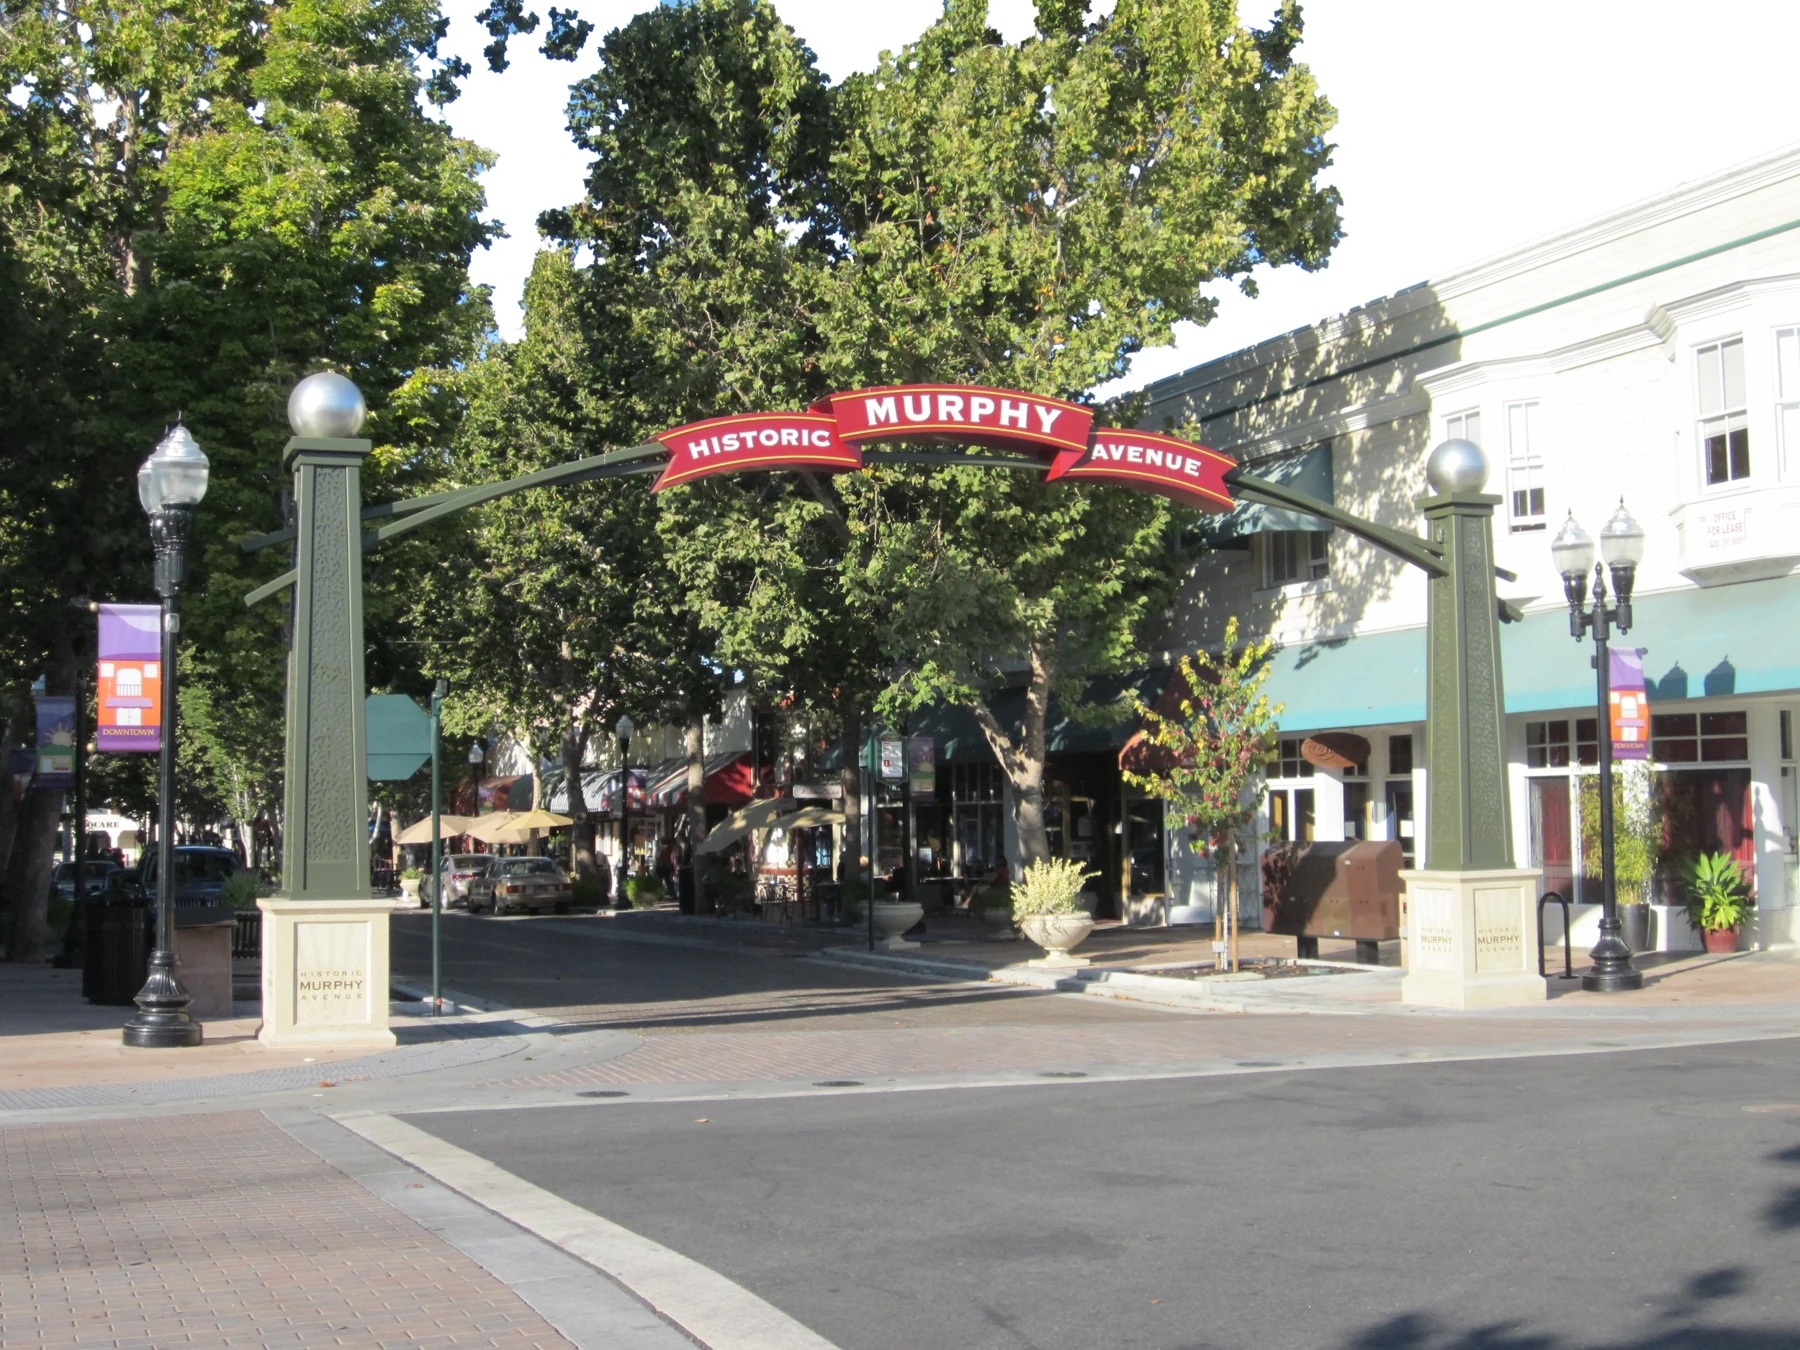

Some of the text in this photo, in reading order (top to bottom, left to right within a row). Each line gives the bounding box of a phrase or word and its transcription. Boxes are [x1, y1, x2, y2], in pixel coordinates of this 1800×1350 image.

[688, 394, 1203, 477] HISTORIC MURPHY AVENUE
[1713, 510, 1737, 523] OFFICE
[1707, 522, 1744, 536] FOR LEASE
[102, 728, 155, 736] DOWNTOWN
[1477, 926, 1519, 934] HISTORIC
[1421, 934, 1453, 945] MURPHY
[1477, 934, 1520, 945] MURPHY
[1479, 945, 1519, 953] AVENUE
[300, 980, 363, 991] MURPHY
[301, 993, 363, 1001] AVENUE
